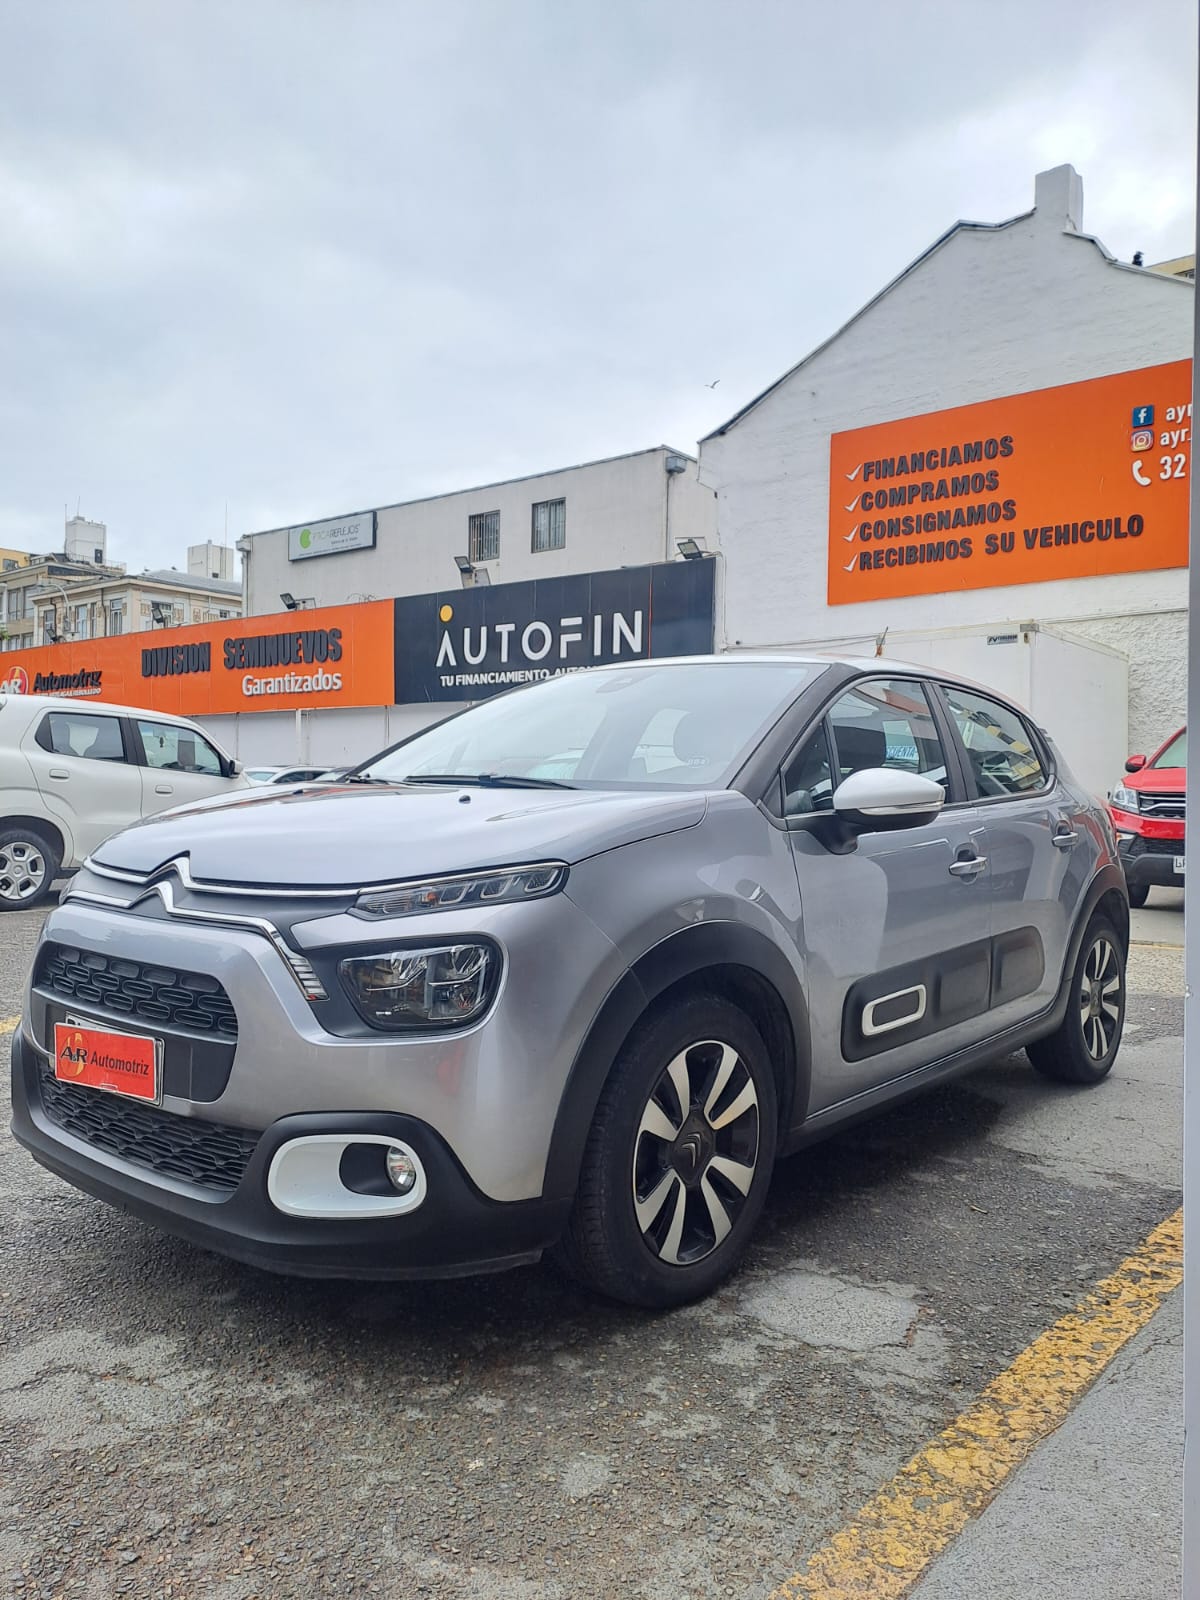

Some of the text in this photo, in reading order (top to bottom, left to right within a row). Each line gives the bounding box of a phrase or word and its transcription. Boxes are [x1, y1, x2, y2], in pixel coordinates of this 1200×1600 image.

[863, 435, 1014, 481] FINANCIAMOS
[1160, 453, 1186, 480] 32
[861, 470, 1000, 511] COMPRAMOS
[859, 499, 1017, 542] CONSIGNAMOS
[859, 514, 1144, 571] RECIBIMOS SU VEHICULO
[141, 628, 343, 678] DIVISION SEMINUEVOS
[436, 606, 643, 667] AUTOFIN
[33, 668, 102, 692] Automotriz
[242, 668, 342, 696] Garantizados
[440, 676, 454, 687] TU
[456, 668, 550, 686] FINANCIAMIENTO
[90, 1051, 150, 1076] Automotriz
